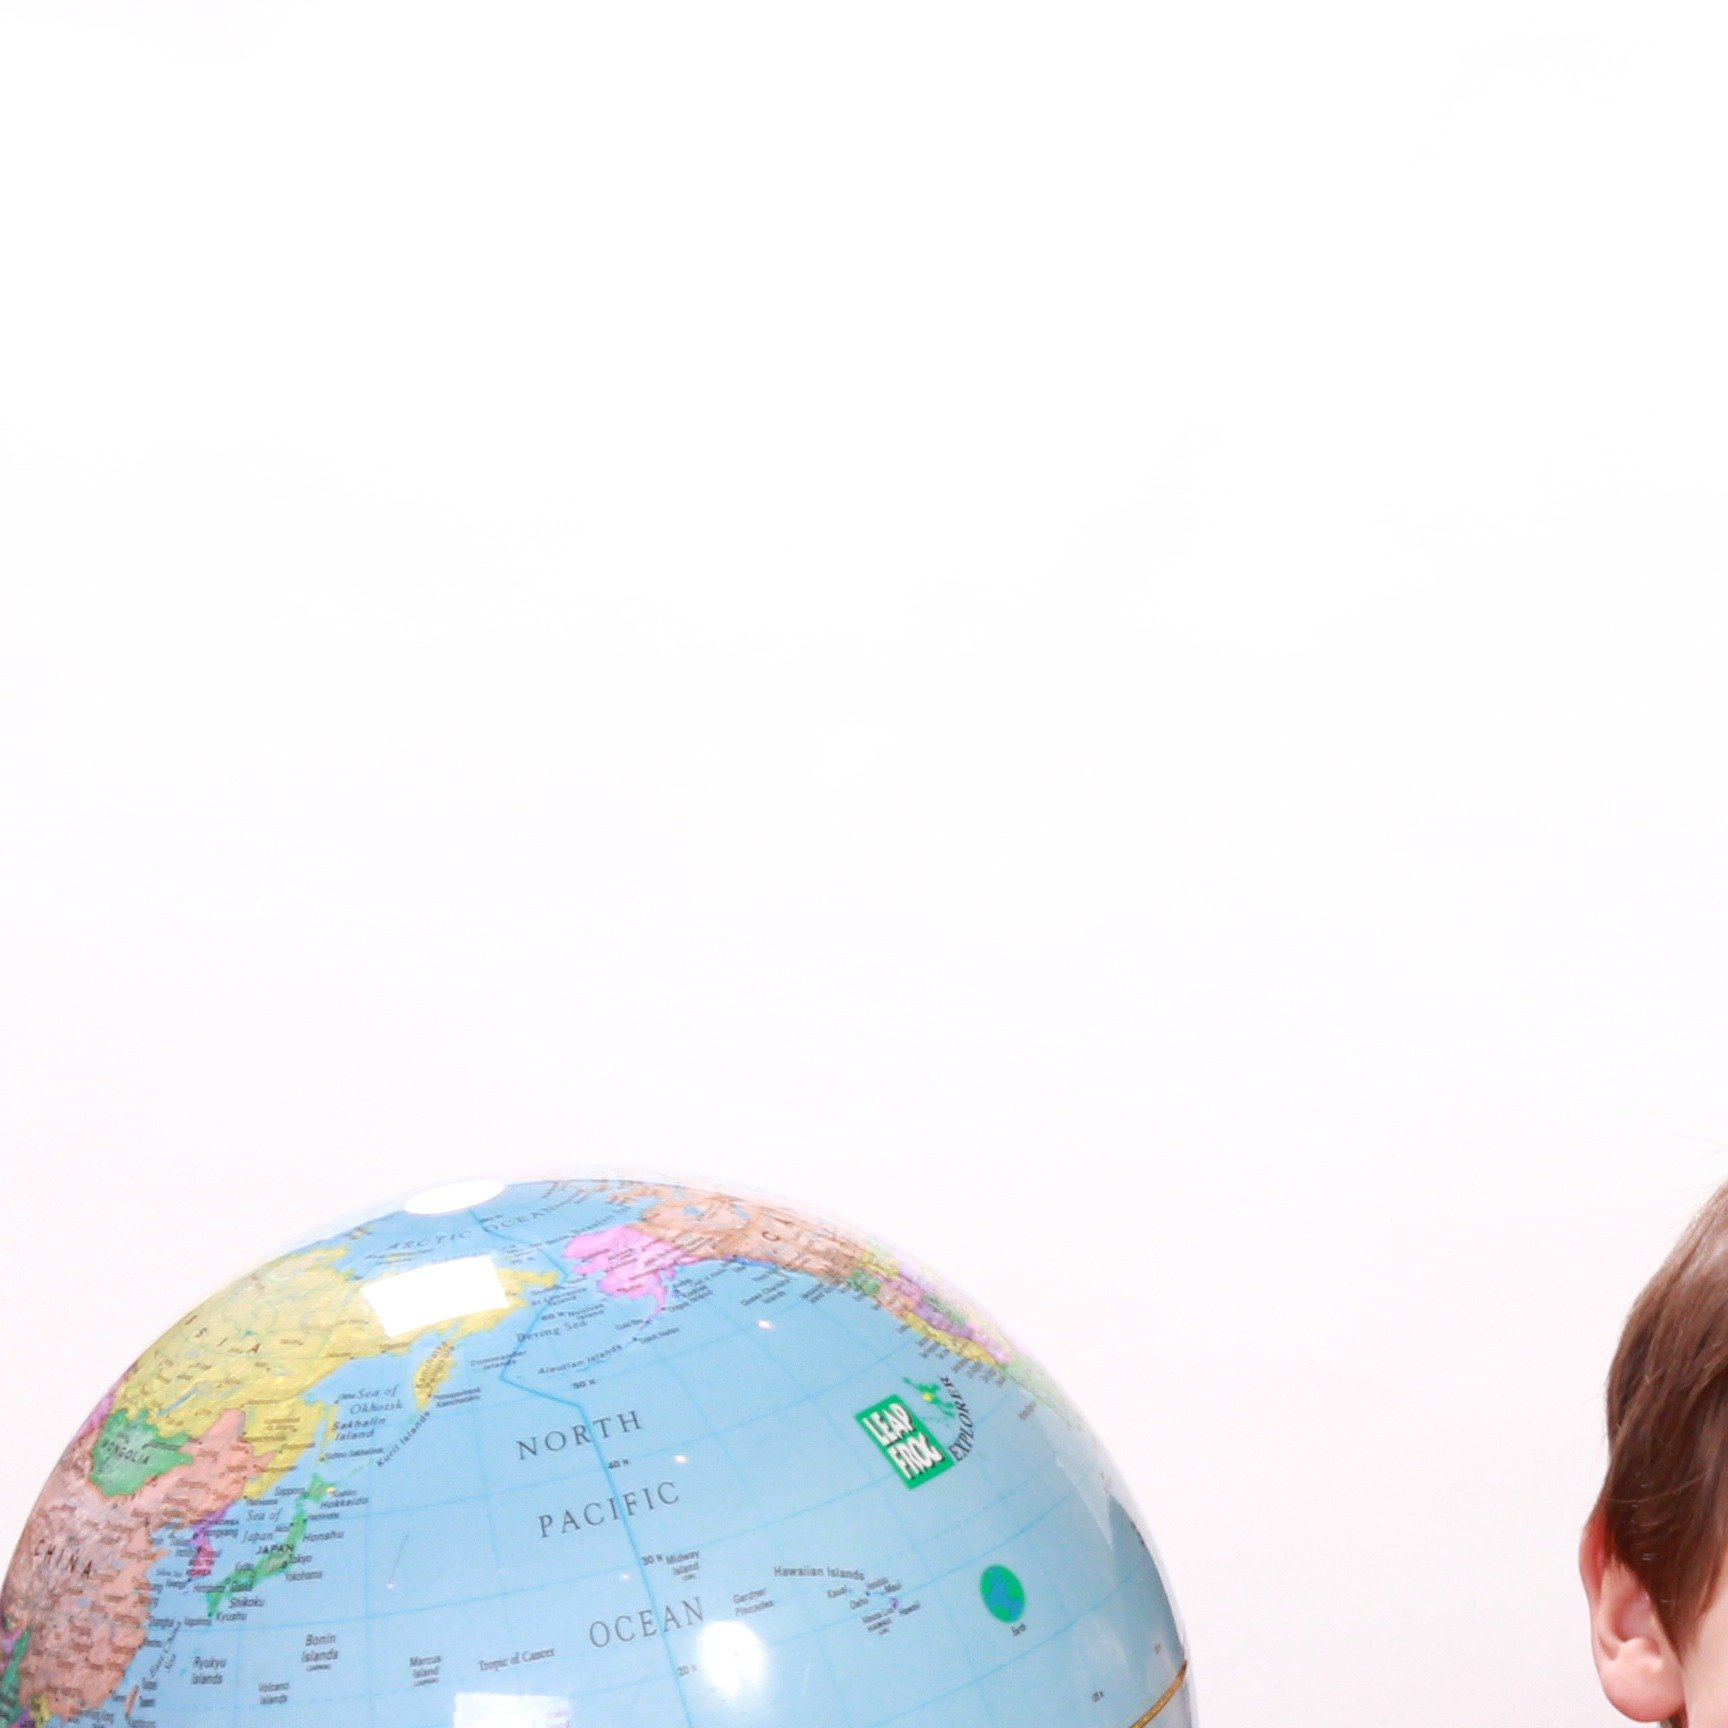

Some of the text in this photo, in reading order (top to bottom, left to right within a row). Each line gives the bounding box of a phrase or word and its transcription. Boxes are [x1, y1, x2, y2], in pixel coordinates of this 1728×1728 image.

[516, 1411, 643, 1461] NORTH
[861, 1402, 916, 1448] LEAP
[887, 1431, 945, 1480] FROG
[538, 1482, 679, 1538] PACIFIC
[255, 1543, 295, 1556] JAPAN
[773, 1565, 867, 1582] Hawaiian Islands
[589, 1596, 705, 1648] OCEAN
